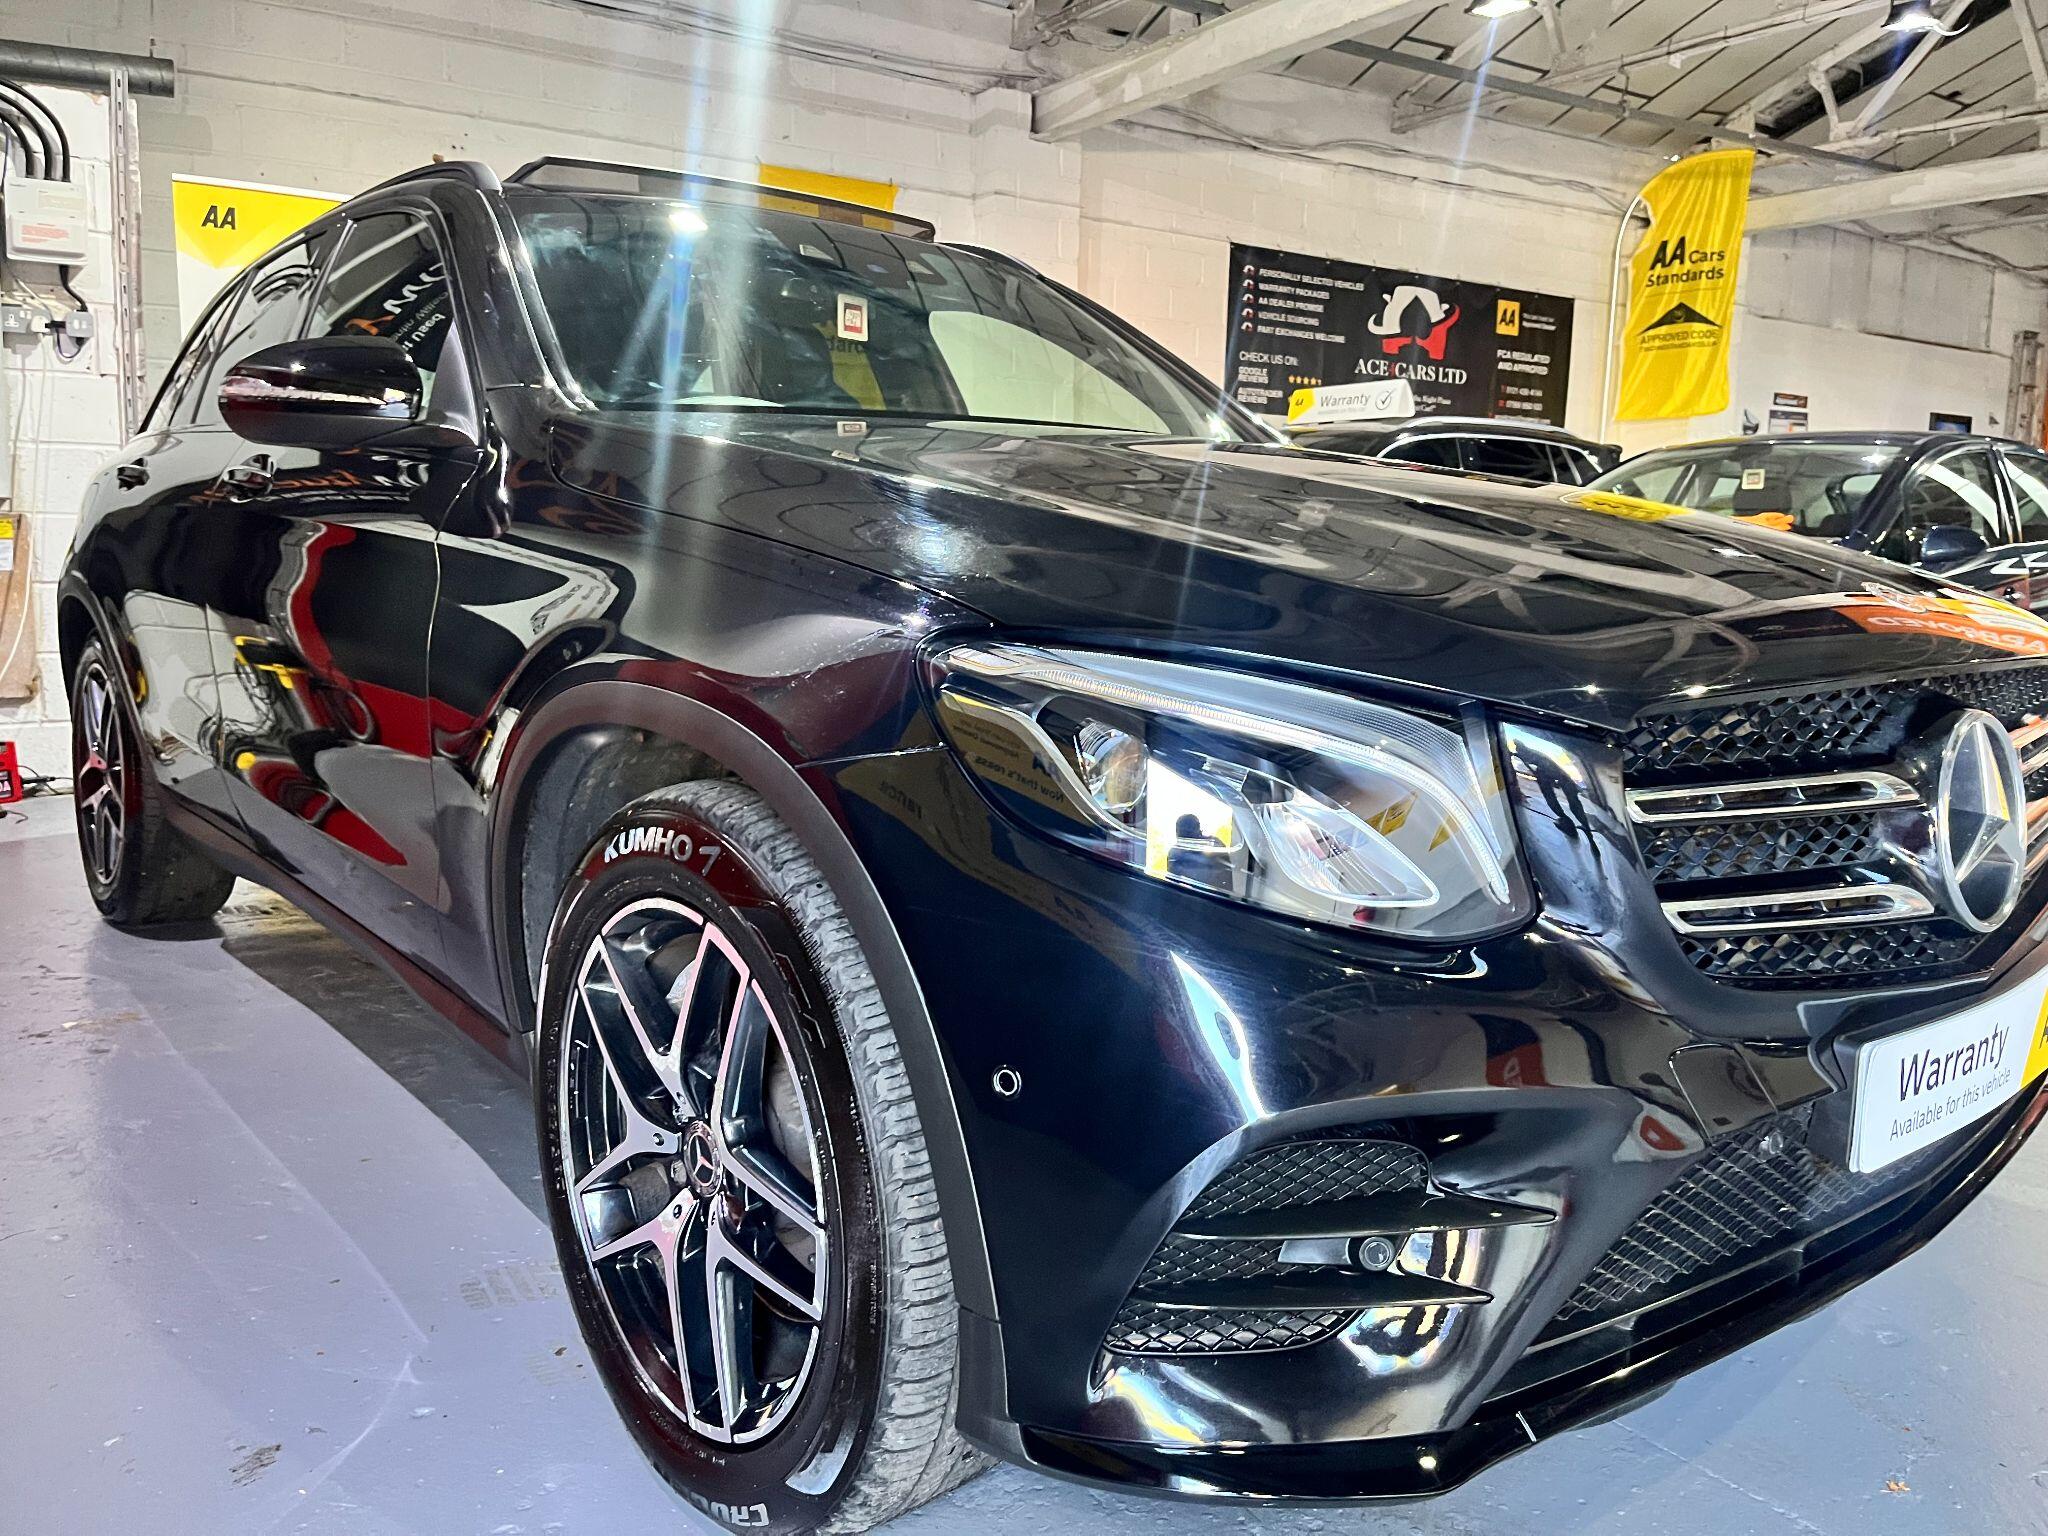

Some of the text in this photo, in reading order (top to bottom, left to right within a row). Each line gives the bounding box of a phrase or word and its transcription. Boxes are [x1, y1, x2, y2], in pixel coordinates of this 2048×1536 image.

[201, 205, 236, 230] AA
[1649, 236, 1725, 271] AA Cars
[1646, 266, 1724, 287] Standards
[1499, 308, 1516, 327] AA
[1239, 351, 1270, 363] CHECK
[1270, 354, 1283, 365] US
[1238, 366, 1268, 376] GOOGLE
[1438, 367, 1467, 385] LTD
[1320, 393, 1371, 408] Warranty
[604, 827, 693, 863] KUMHO
[1900, 1022, 2010, 1102] Warranty
[1889, 1067, 2011, 1141] Available for this vehicle
